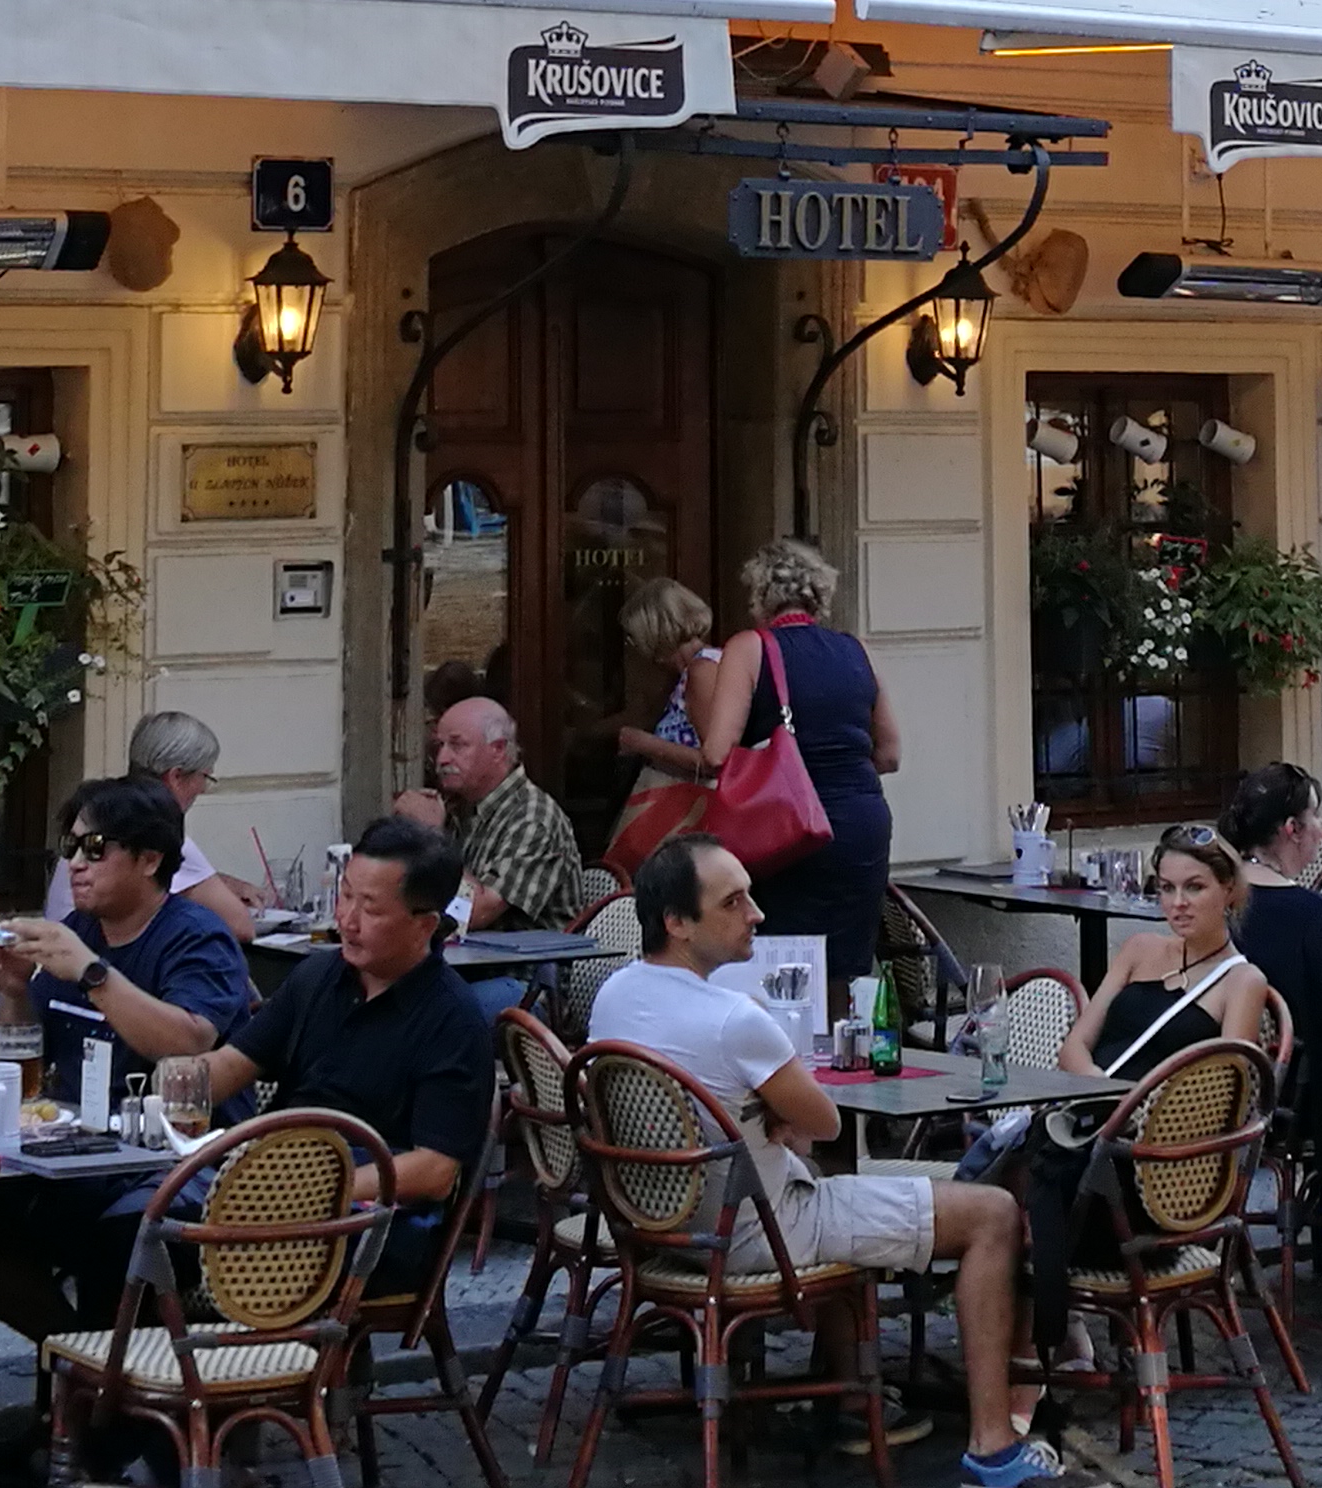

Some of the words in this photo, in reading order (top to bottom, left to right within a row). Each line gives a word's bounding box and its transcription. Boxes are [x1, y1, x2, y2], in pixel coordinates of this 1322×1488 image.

[527, 58, 665, 106] KRUŠOVICE
[286, 173, 307, 213] 6
[755, 189, 924, 253] HOTEL
[227, 455, 270, 468] HOTEL
